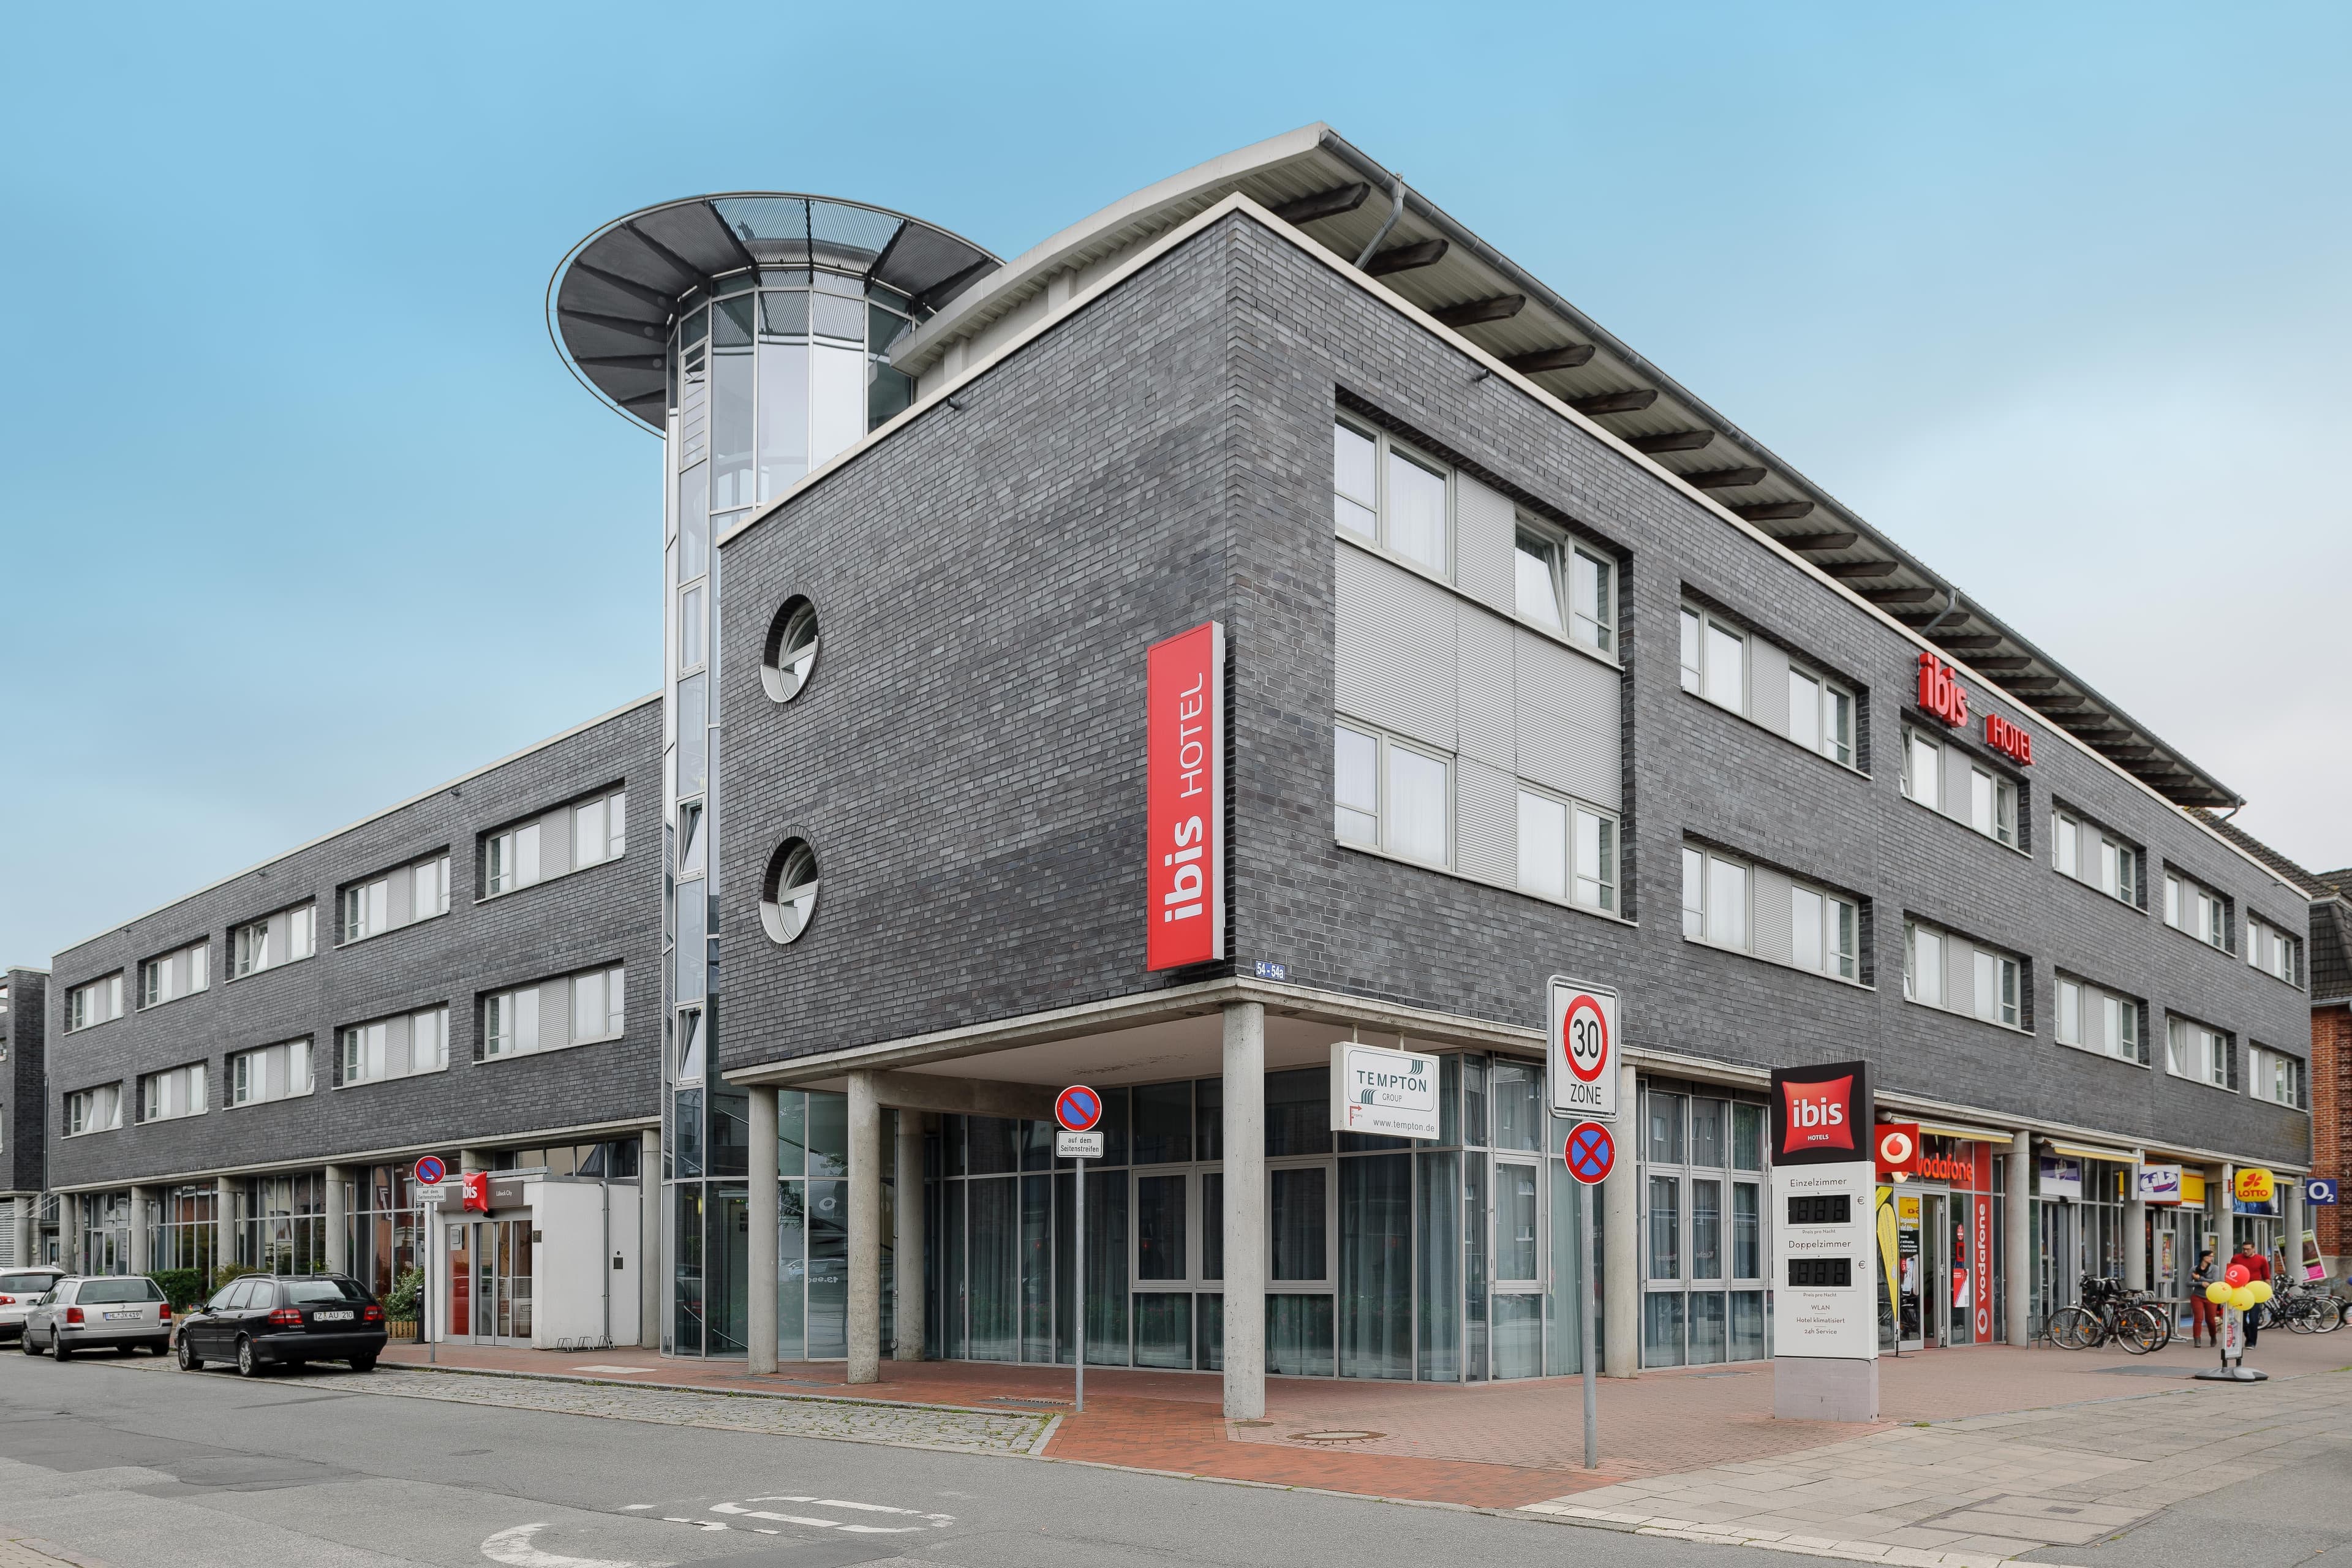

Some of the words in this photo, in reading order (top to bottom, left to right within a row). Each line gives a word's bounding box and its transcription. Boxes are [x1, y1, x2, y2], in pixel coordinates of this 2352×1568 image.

[1919, 652, 1968, 727] ibis
[1986, 714, 2036, 766] HOTEL
[1180, 672, 1203, 798] HOTEL
[1164, 815, 1203, 922] ibis
[1257, 962, 1266, 975] 54
[1271, 965, 1284, 979] 54a
[1573, 1019, 1599, 1058] 30
[1357, 1070, 1427, 1093] TEMPTON
[1382, 1093, 1402, 1102] GROUP
[1570, 1083, 1602, 1105] ZONE
[1793, 1097, 1843, 1128] ibis
[1373, 1119, 1434, 1132] www.tempton.de
[1917, 1153, 1973, 1182] vodafone
[1790, 1178, 1847, 1187] Einzelzimmer
[1857, 1196, 1865, 1205] €
[1789, 1240, 1852, 1250] Doppelzimmer
[1858, 1260, 1866, 1269] €
